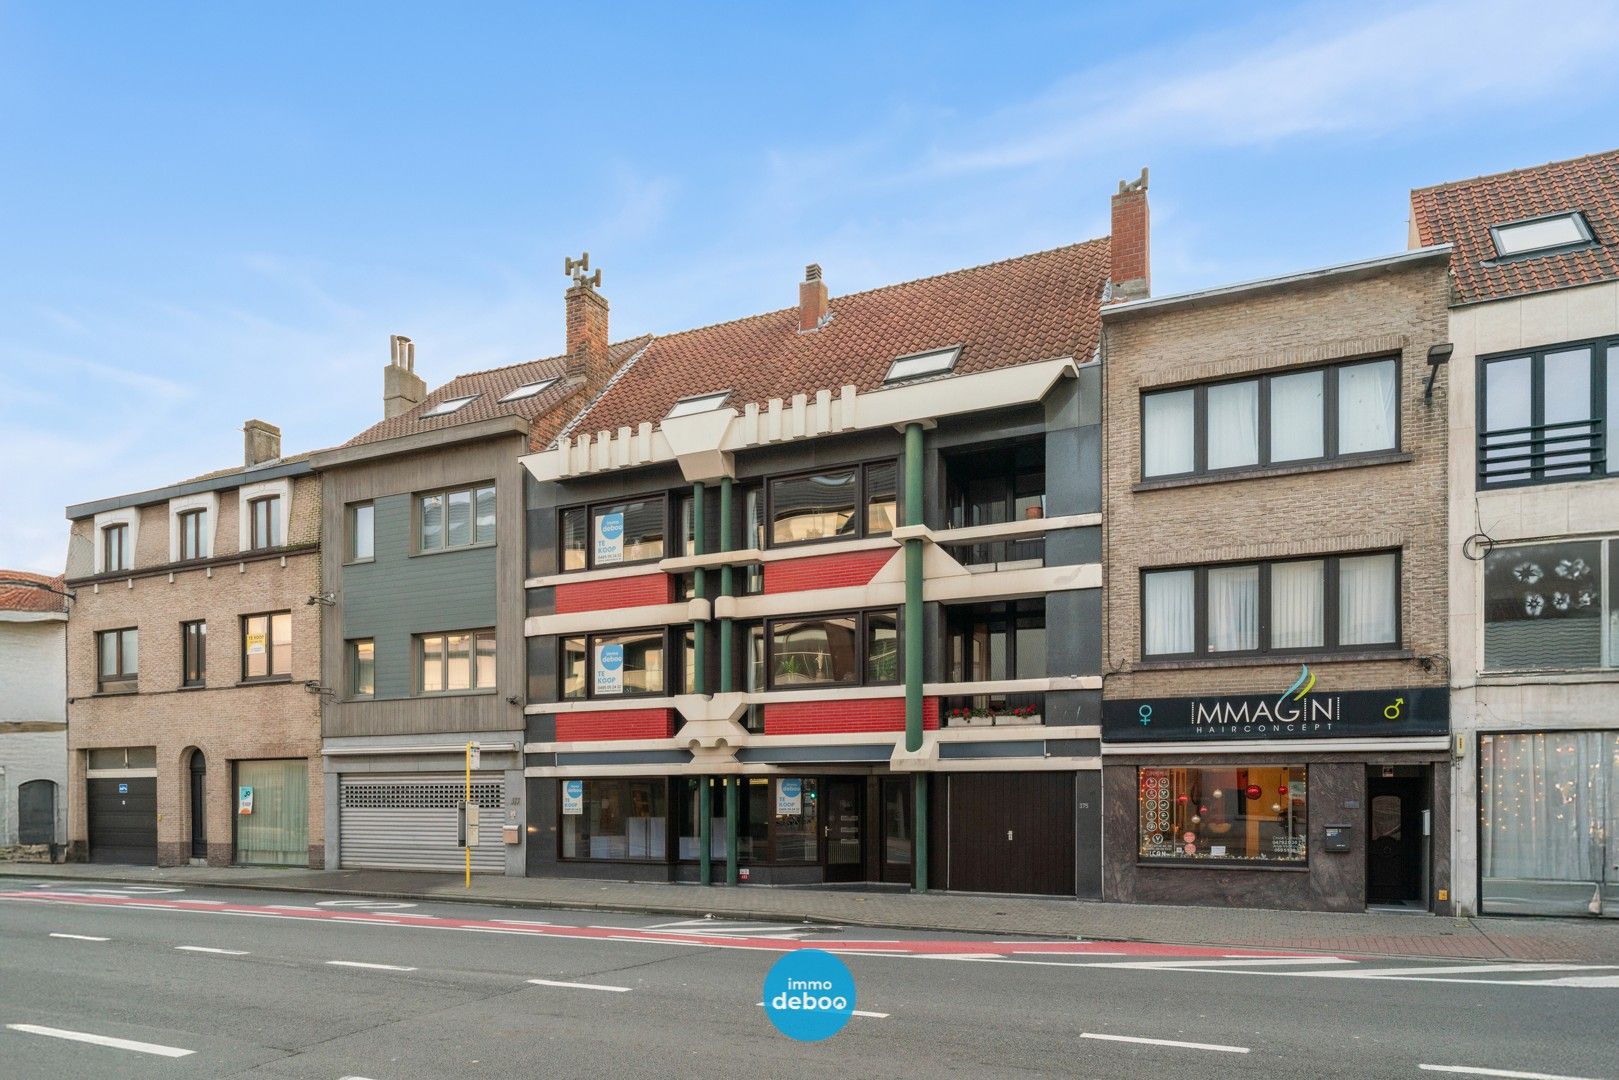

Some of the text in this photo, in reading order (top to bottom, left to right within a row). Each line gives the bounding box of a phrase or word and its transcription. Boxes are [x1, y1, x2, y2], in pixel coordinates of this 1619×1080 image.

[598, 546, 616, 554] KOOP
[1191, 690, 1340, 724] IMMAGINI
[1196, 723, 1333, 734] HAIRCONCEPT
